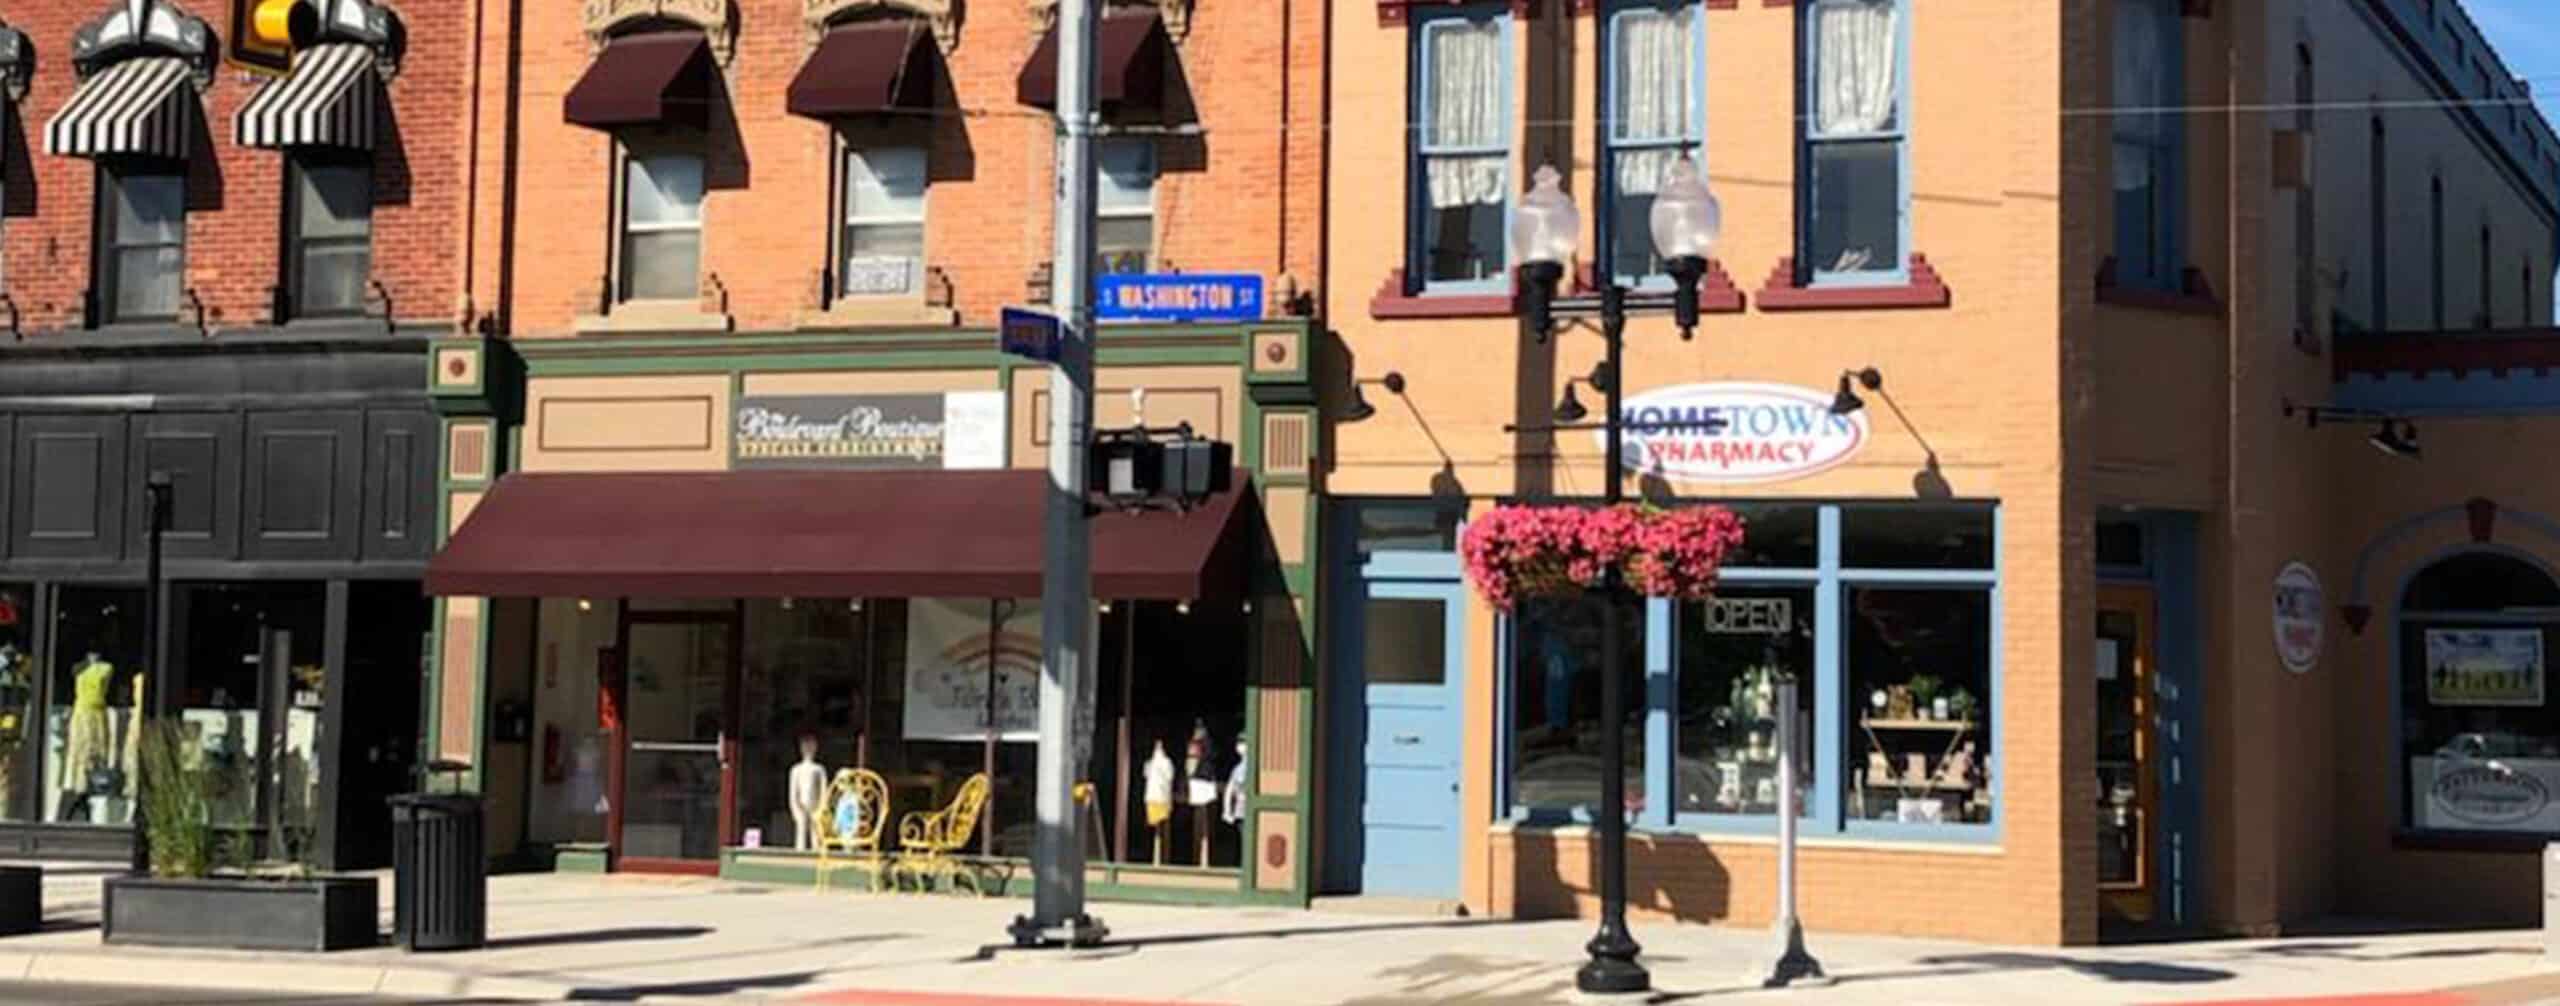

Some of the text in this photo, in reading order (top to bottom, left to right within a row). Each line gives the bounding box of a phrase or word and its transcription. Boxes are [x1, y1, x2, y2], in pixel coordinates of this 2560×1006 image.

[1118, 284, 1234, 309] WASHINGTON
[1648, 440, 1814, 468] PHARMACY
[1707, 599, 1789, 632] OPEN
